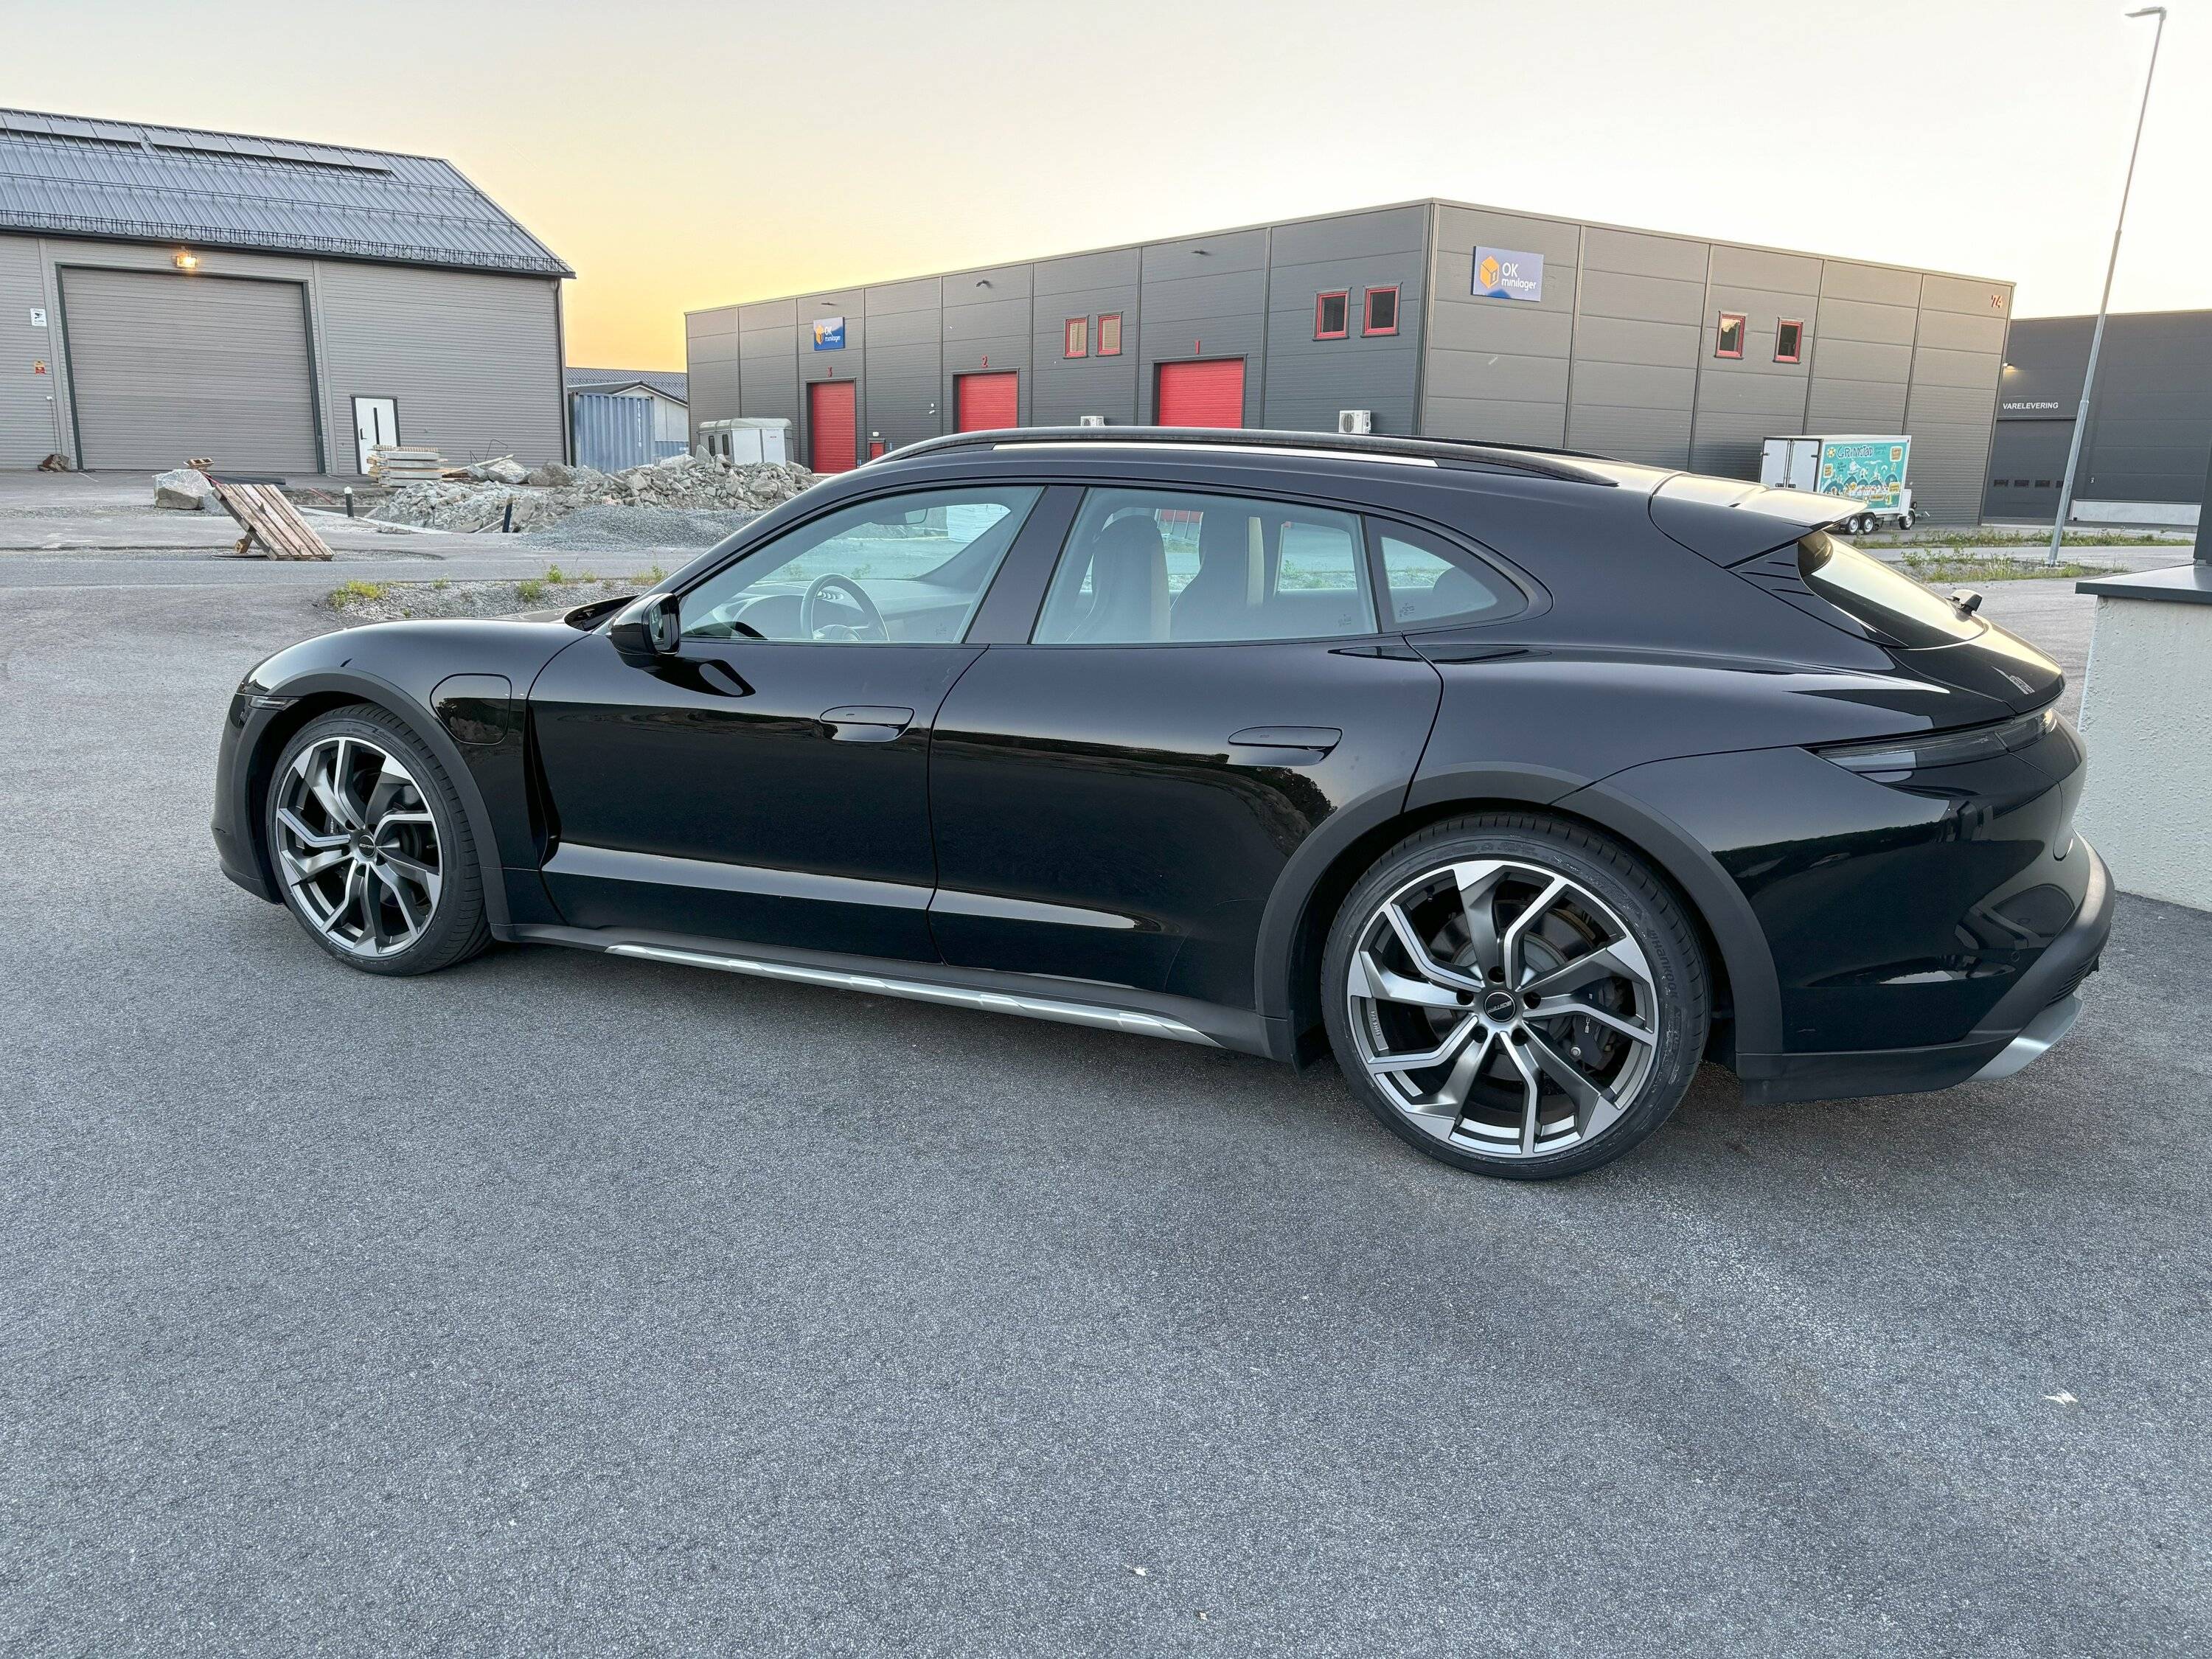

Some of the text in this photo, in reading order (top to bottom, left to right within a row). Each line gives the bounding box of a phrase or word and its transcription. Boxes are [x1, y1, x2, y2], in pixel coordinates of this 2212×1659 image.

[1502, 262, 1518, 277] OK
[1501, 277, 1537, 291] minilager
[1991, 295, 2003, 308] 74
[824, 326, 832, 335] OK
[1194, 340, 1200, 355] 1
[980, 355, 989, 368] 2
[2003, 402, 2059, 410] VARELEVERING
